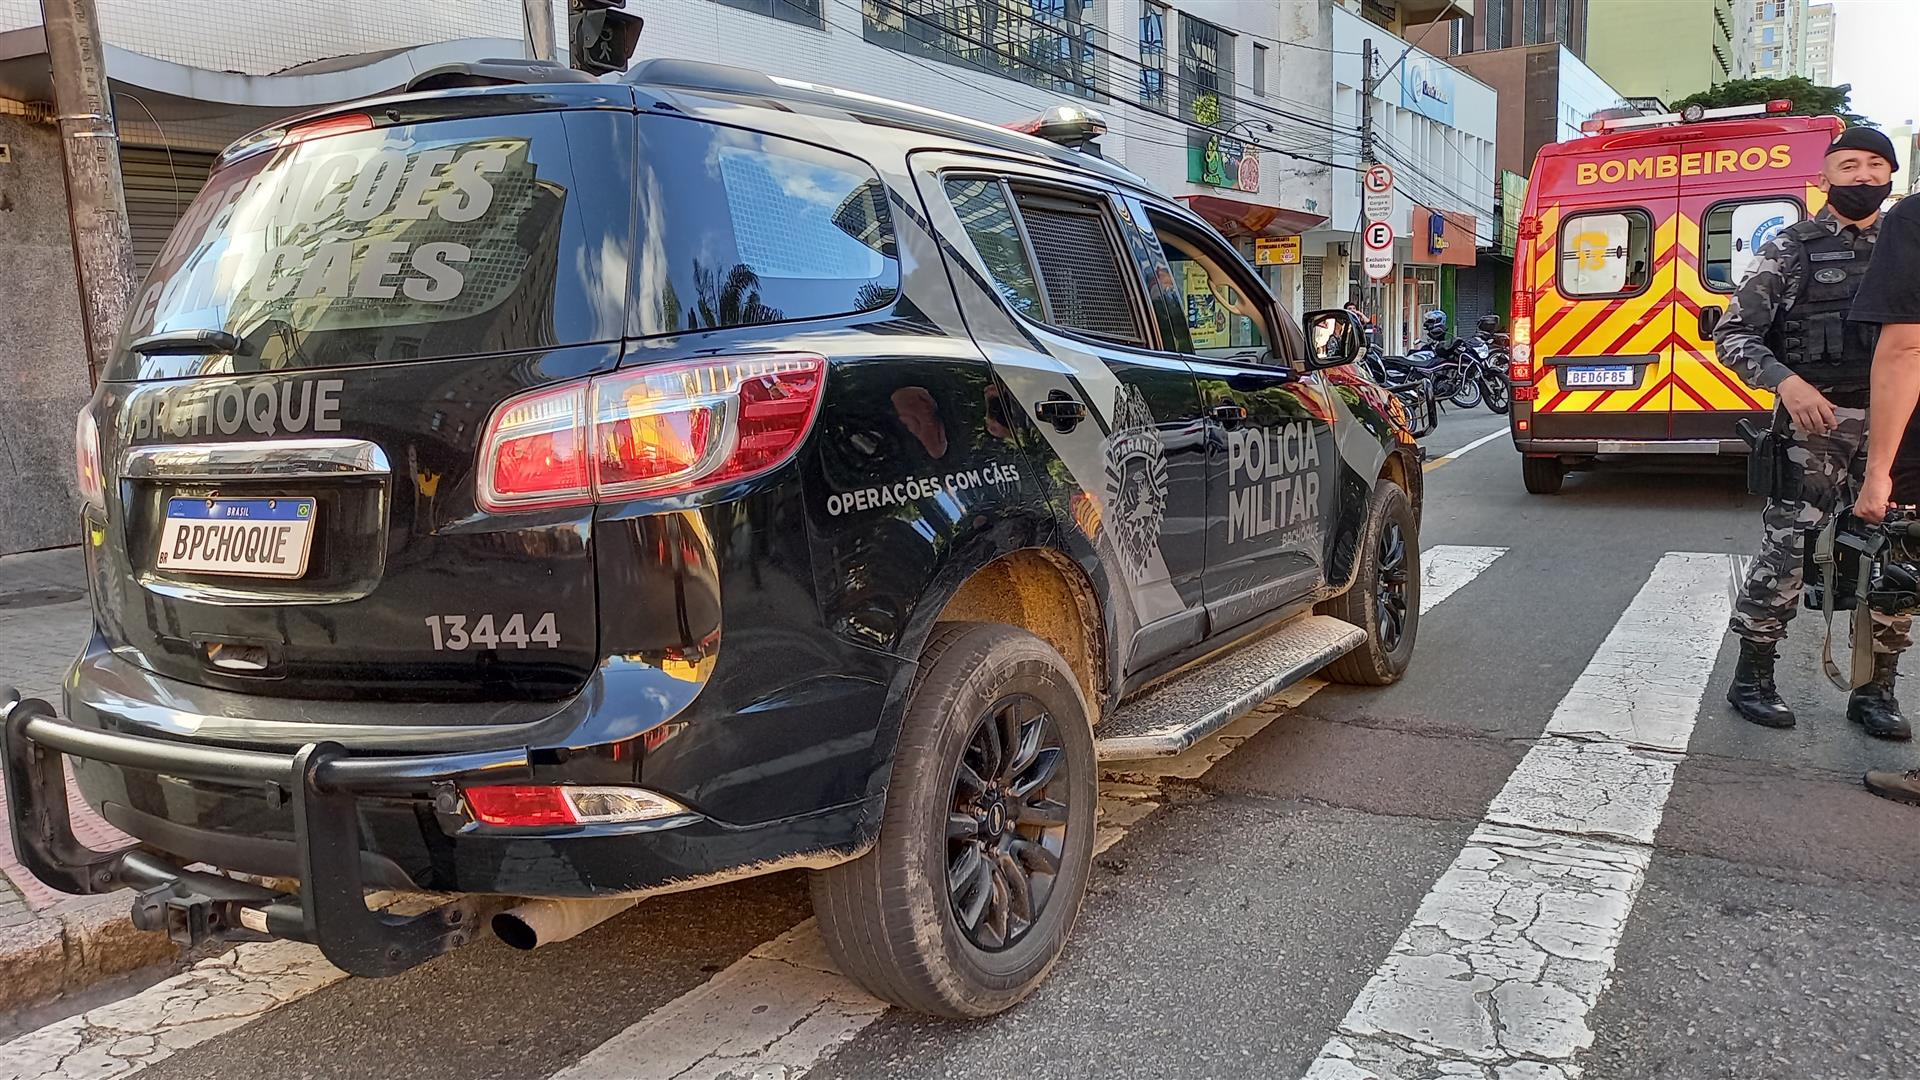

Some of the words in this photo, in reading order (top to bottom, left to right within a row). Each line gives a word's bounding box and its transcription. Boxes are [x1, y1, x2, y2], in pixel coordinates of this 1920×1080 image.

[1576, 144, 1792, 186] BOMBEIROS
[1373, 228, 1385, 244] E
[249, 228, 471, 301] CÃES
[1572, 371, 1626, 383] BED6F85
[135, 379, 344, 440] BPCHOQUE
[1114, 438, 1156, 464] PARANÁ
[826, 475, 943, 516] OPERAÇÕES
[944, 468, 983, 493] COM
[983, 462, 1021, 484] CÃES
[1227, 472, 1320, 544] MILITAR
[226, 506, 250, 517] BRASIL
[158, 551, 169, 564] BR
[172, 525, 291, 564] BPCHOQUE
[424, 612, 562, 651] 13444
